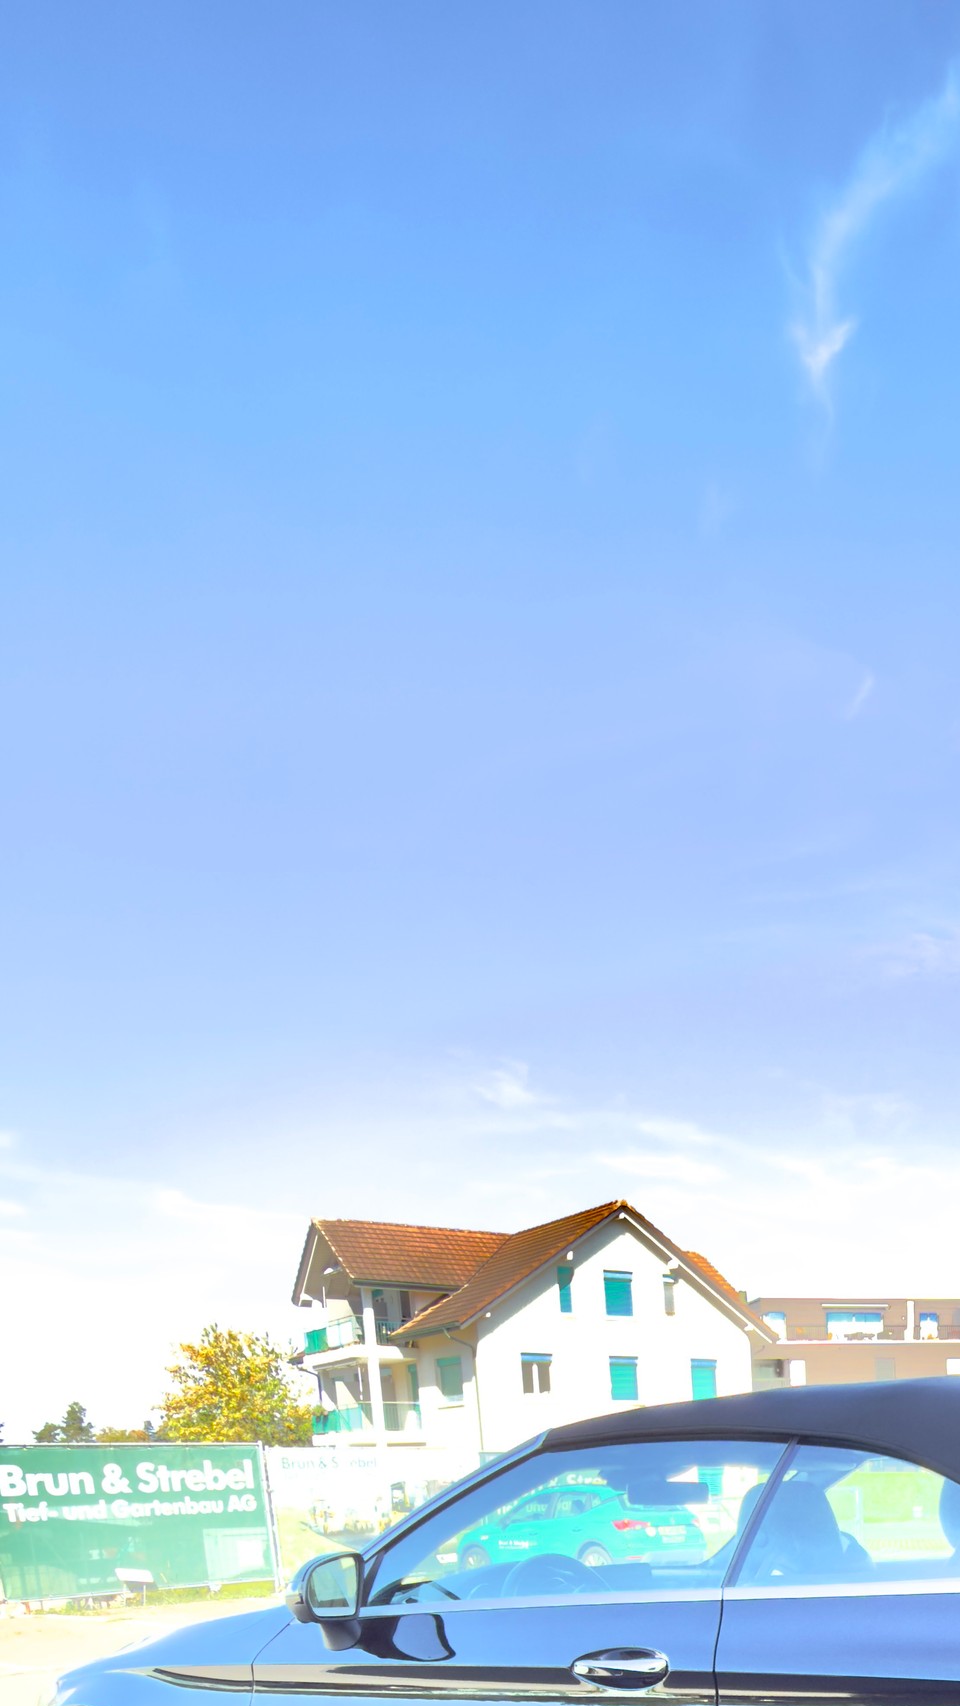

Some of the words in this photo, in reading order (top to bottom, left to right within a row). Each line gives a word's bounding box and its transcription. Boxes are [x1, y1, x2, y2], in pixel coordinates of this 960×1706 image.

[0, 1464, 95, 1496] Brun
[101, 1463, 133, 1494] &
[136, 1459, 255, 1493] Strebel
[281, 1457, 315, 1470] Brun
[318, 1457, 328, 1469] &
[330, 1457, 377, 1469] Sebel
[3, 1501, 58, 1522] Tief-
[62, 1499, 106, 1520] und
[111, 1496, 224, 1518] Gartenbau
[227, 1494, 257, 1512] AG
